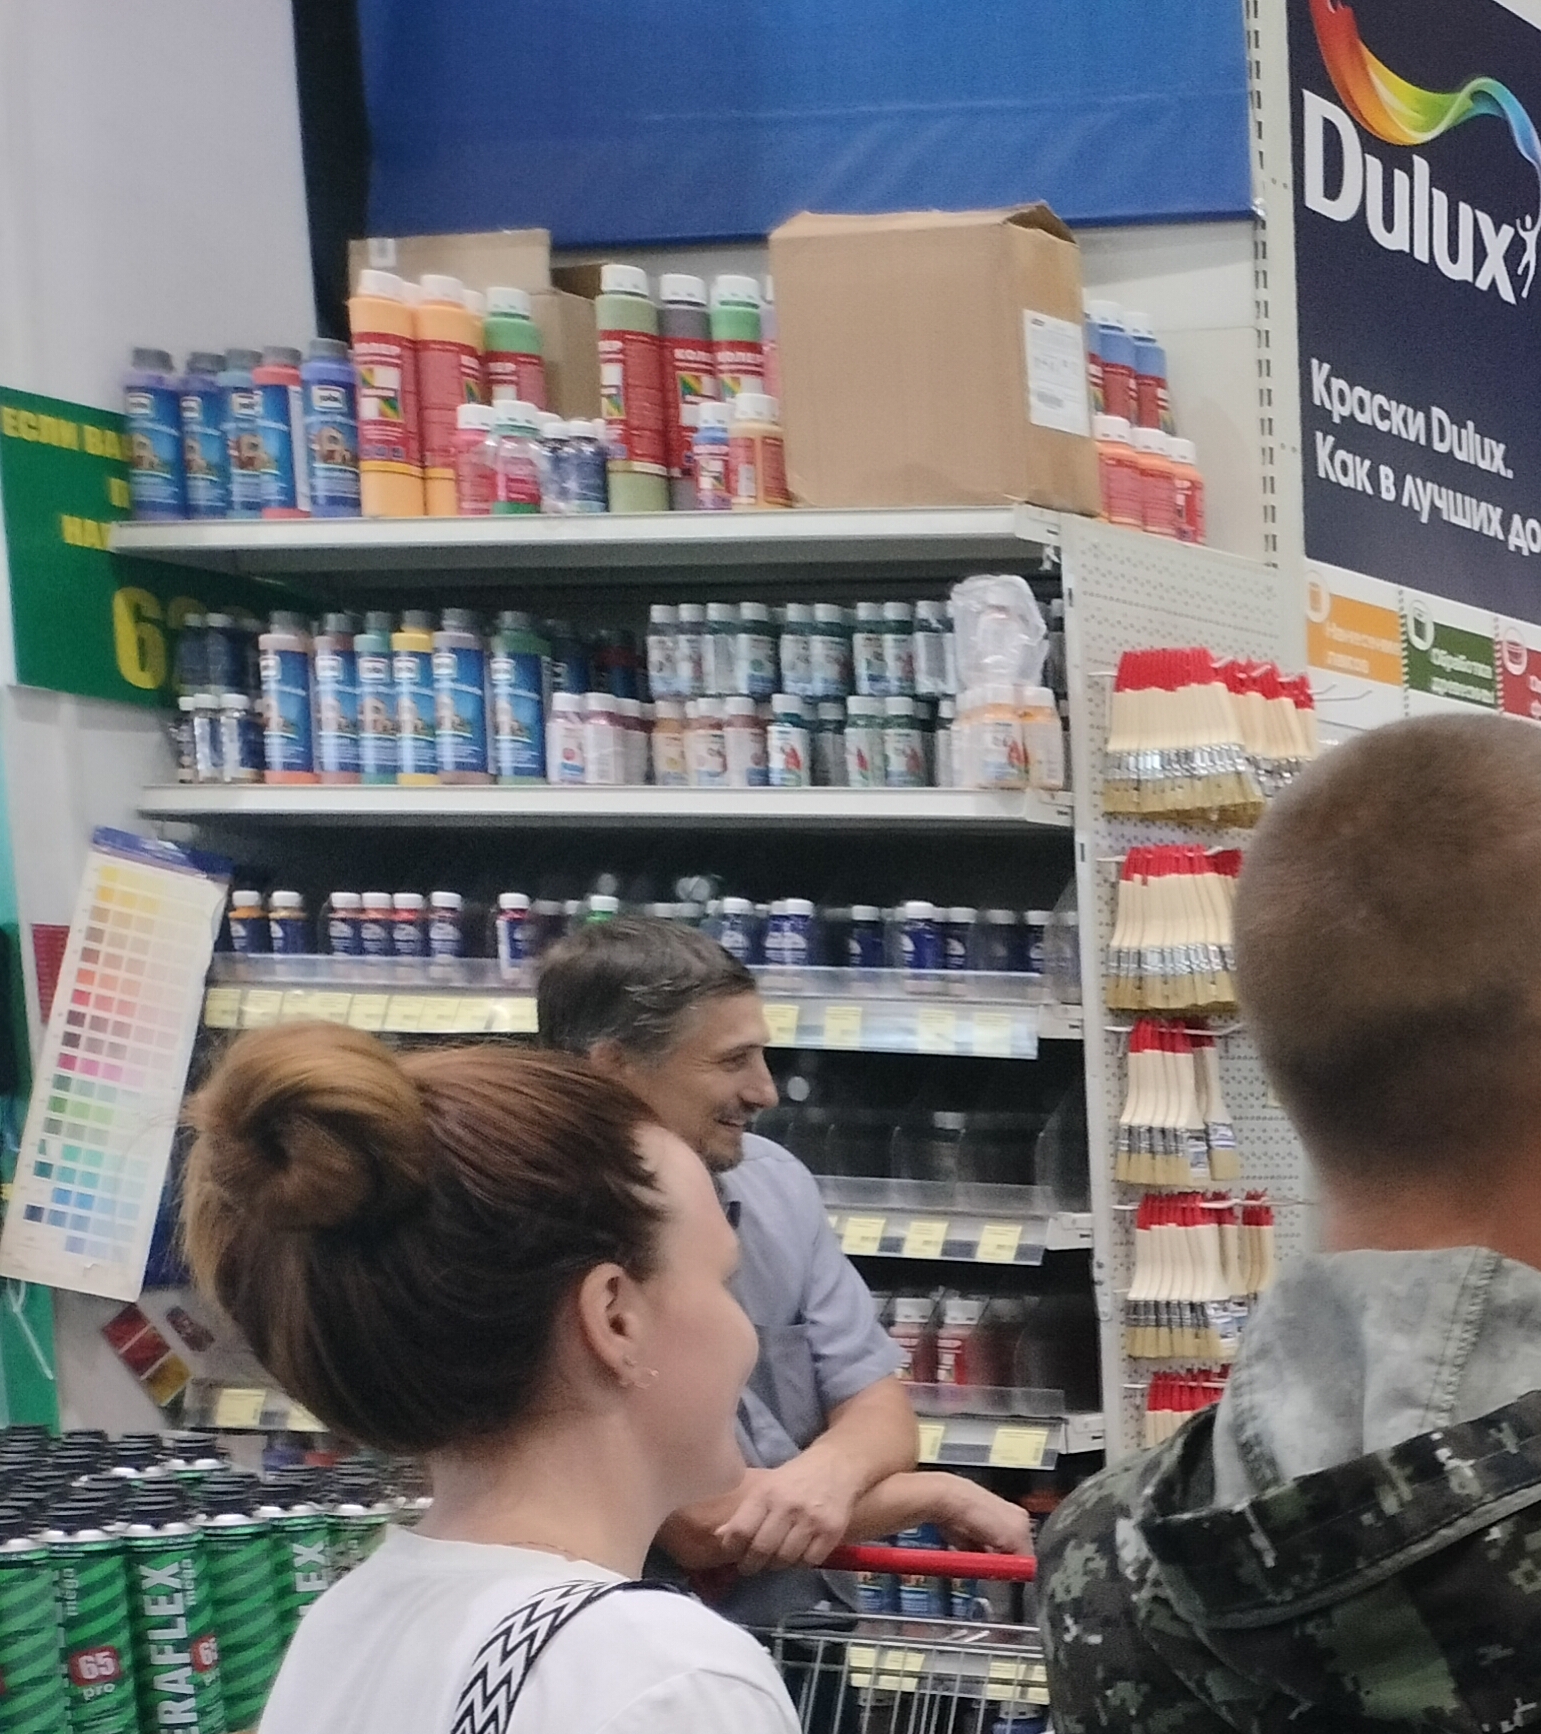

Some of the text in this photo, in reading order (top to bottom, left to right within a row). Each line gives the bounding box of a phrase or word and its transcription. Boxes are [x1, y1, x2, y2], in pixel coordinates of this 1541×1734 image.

[1303, 88, 1518, 305] Dulux
[1310, 358, 1514, 480] Краски Dulux.
[1315, 431, 1372, 499] Как
[1379, 468, 1397, 502] в
[1401, 473, 1504, 543] лучших
[77, 1651, 117, 1680] 65
[83, 1680, 115, 1702] pro
